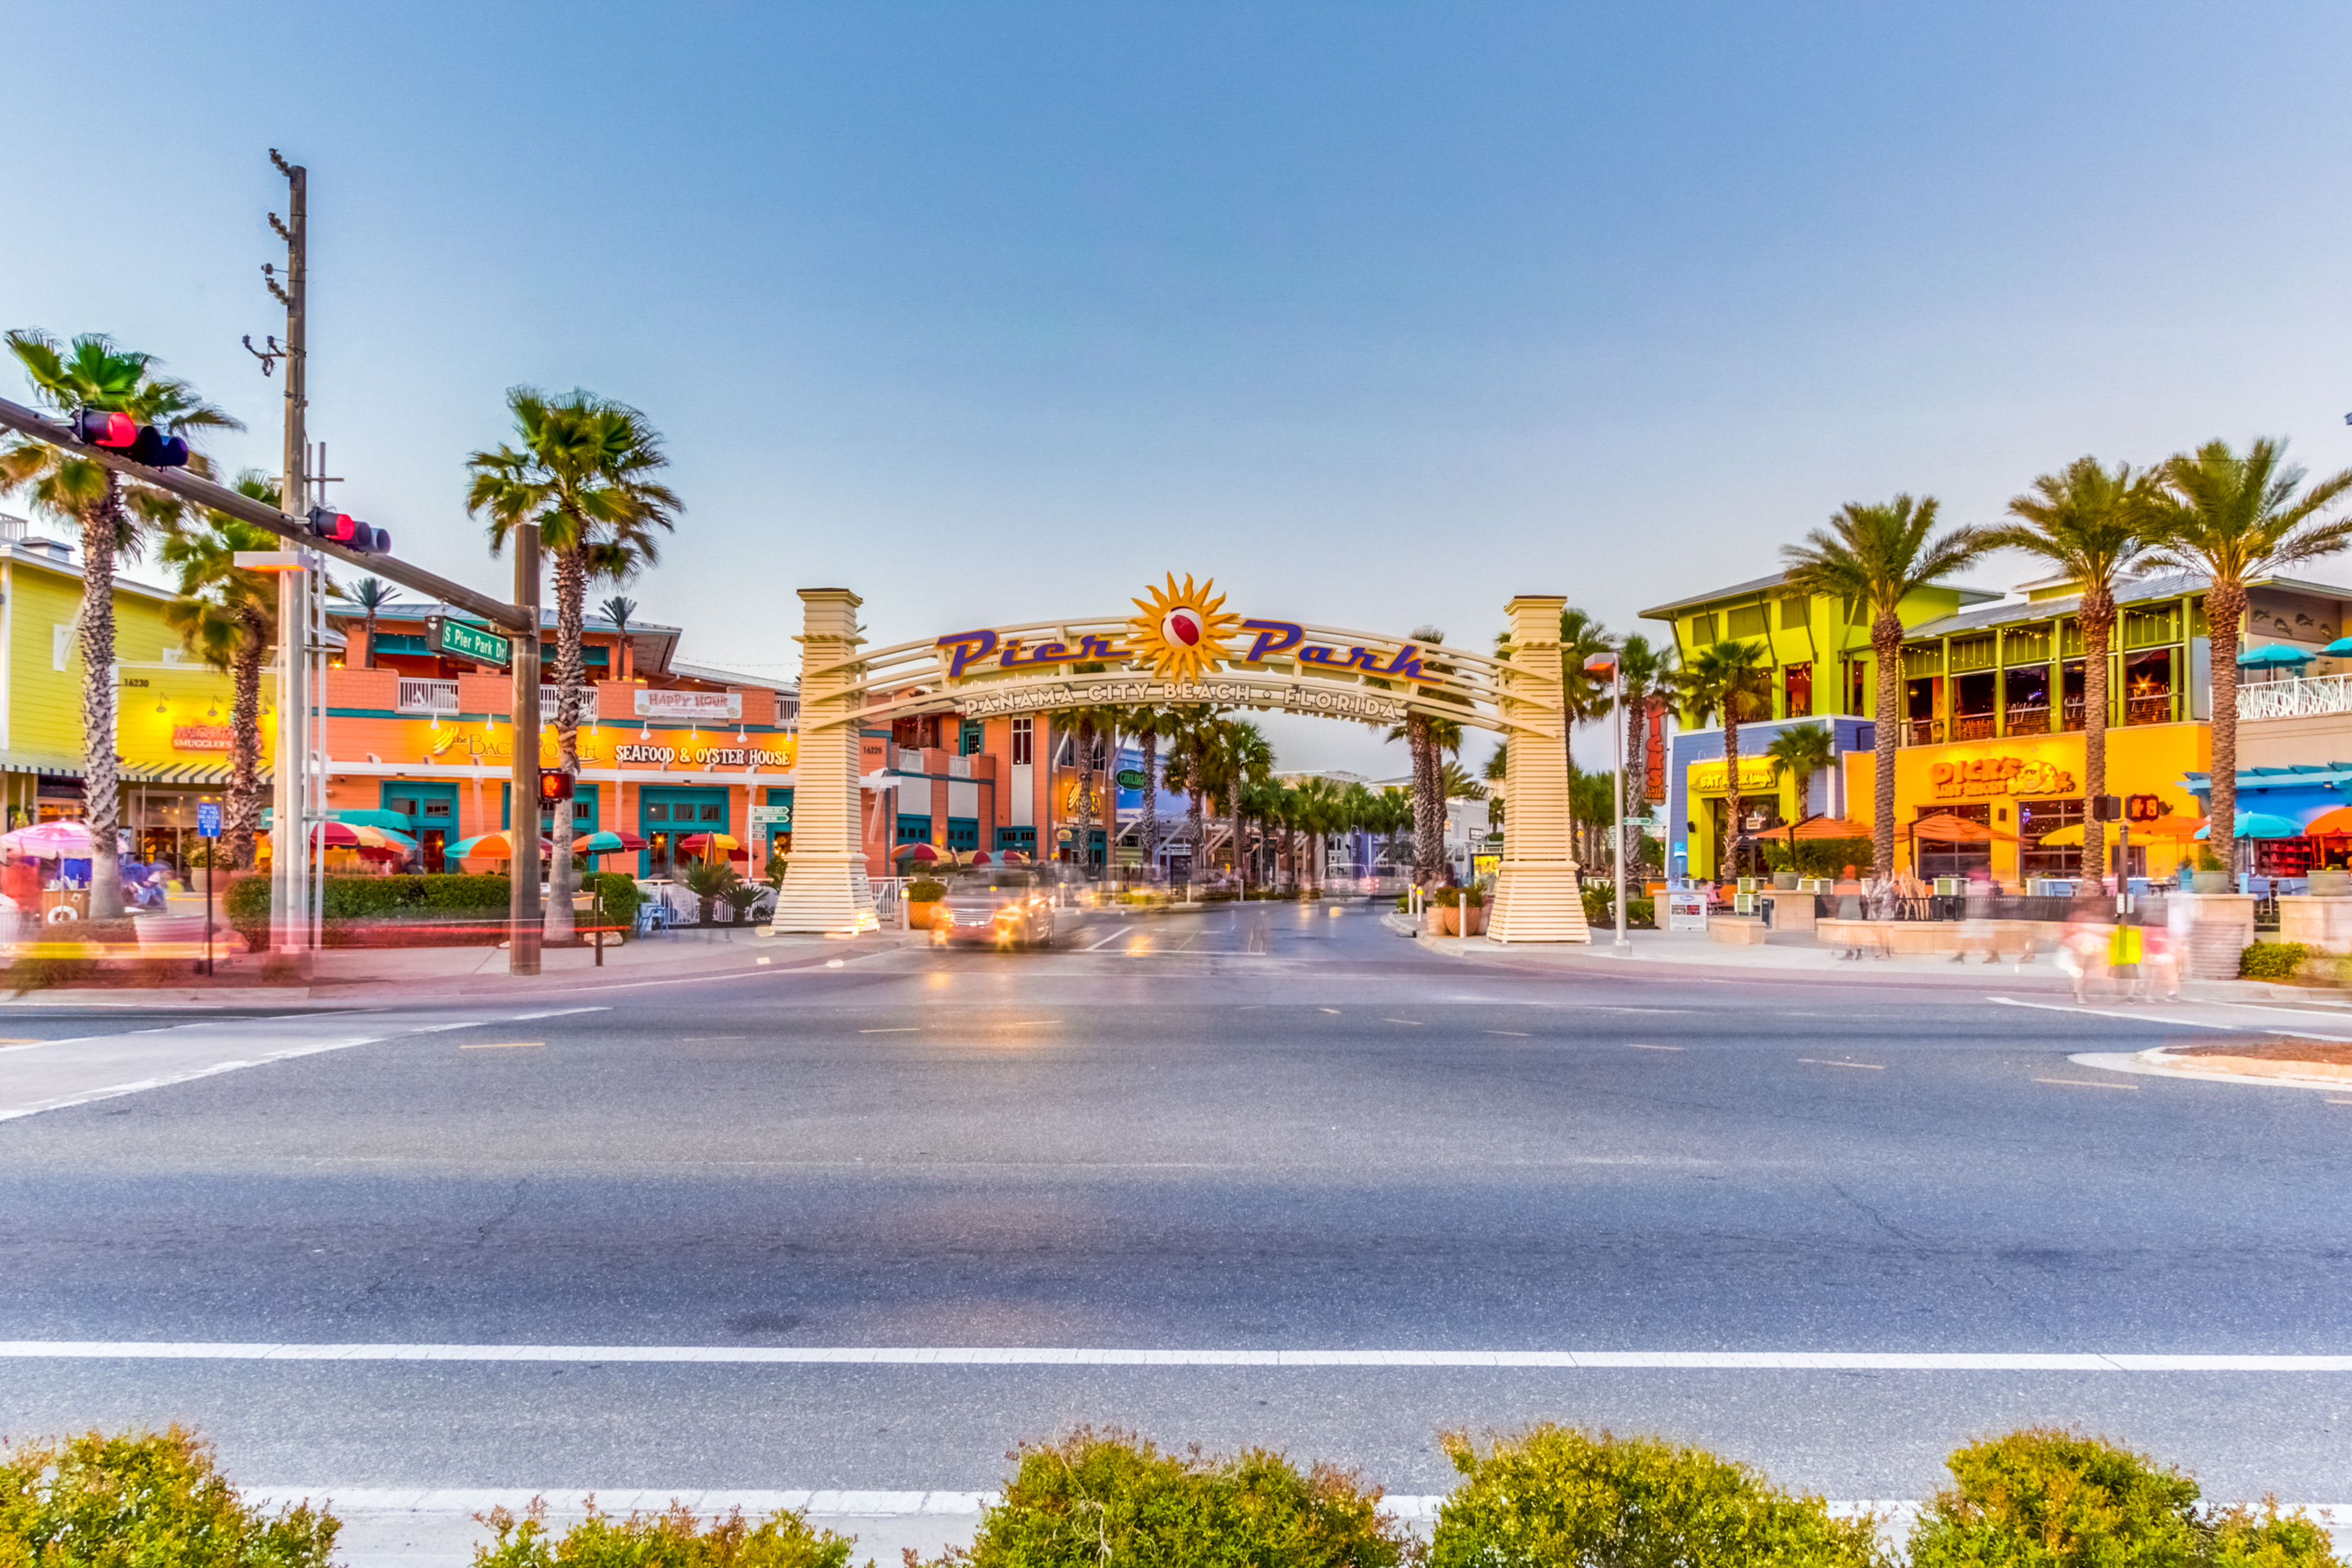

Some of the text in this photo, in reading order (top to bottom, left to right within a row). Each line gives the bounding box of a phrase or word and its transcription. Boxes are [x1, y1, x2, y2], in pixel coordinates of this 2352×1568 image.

[444, 625, 505, 659] S Pier Park Dr
[935, 618, 1445, 684] Pier Park
[124, 679, 149, 688] 16230
[649, 694, 729, 708] HAPPY HOUR
[966, 682, 1397, 720] PANAMA CITY BEACH FLORIDA
[173, 739, 232, 748] SMUGGLER'S
[452, 733, 598, 759] the BAC OCH
[615, 745, 791, 765] SEAFOOD & OYSTER HOUSE
[1701, 774, 1722, 788] EAT
[1750, 770, 1772, 787] laugh
[1933, 756, 2022, 785] DICK'S
[1935, 781, 2008, 798] LAST RESORT
